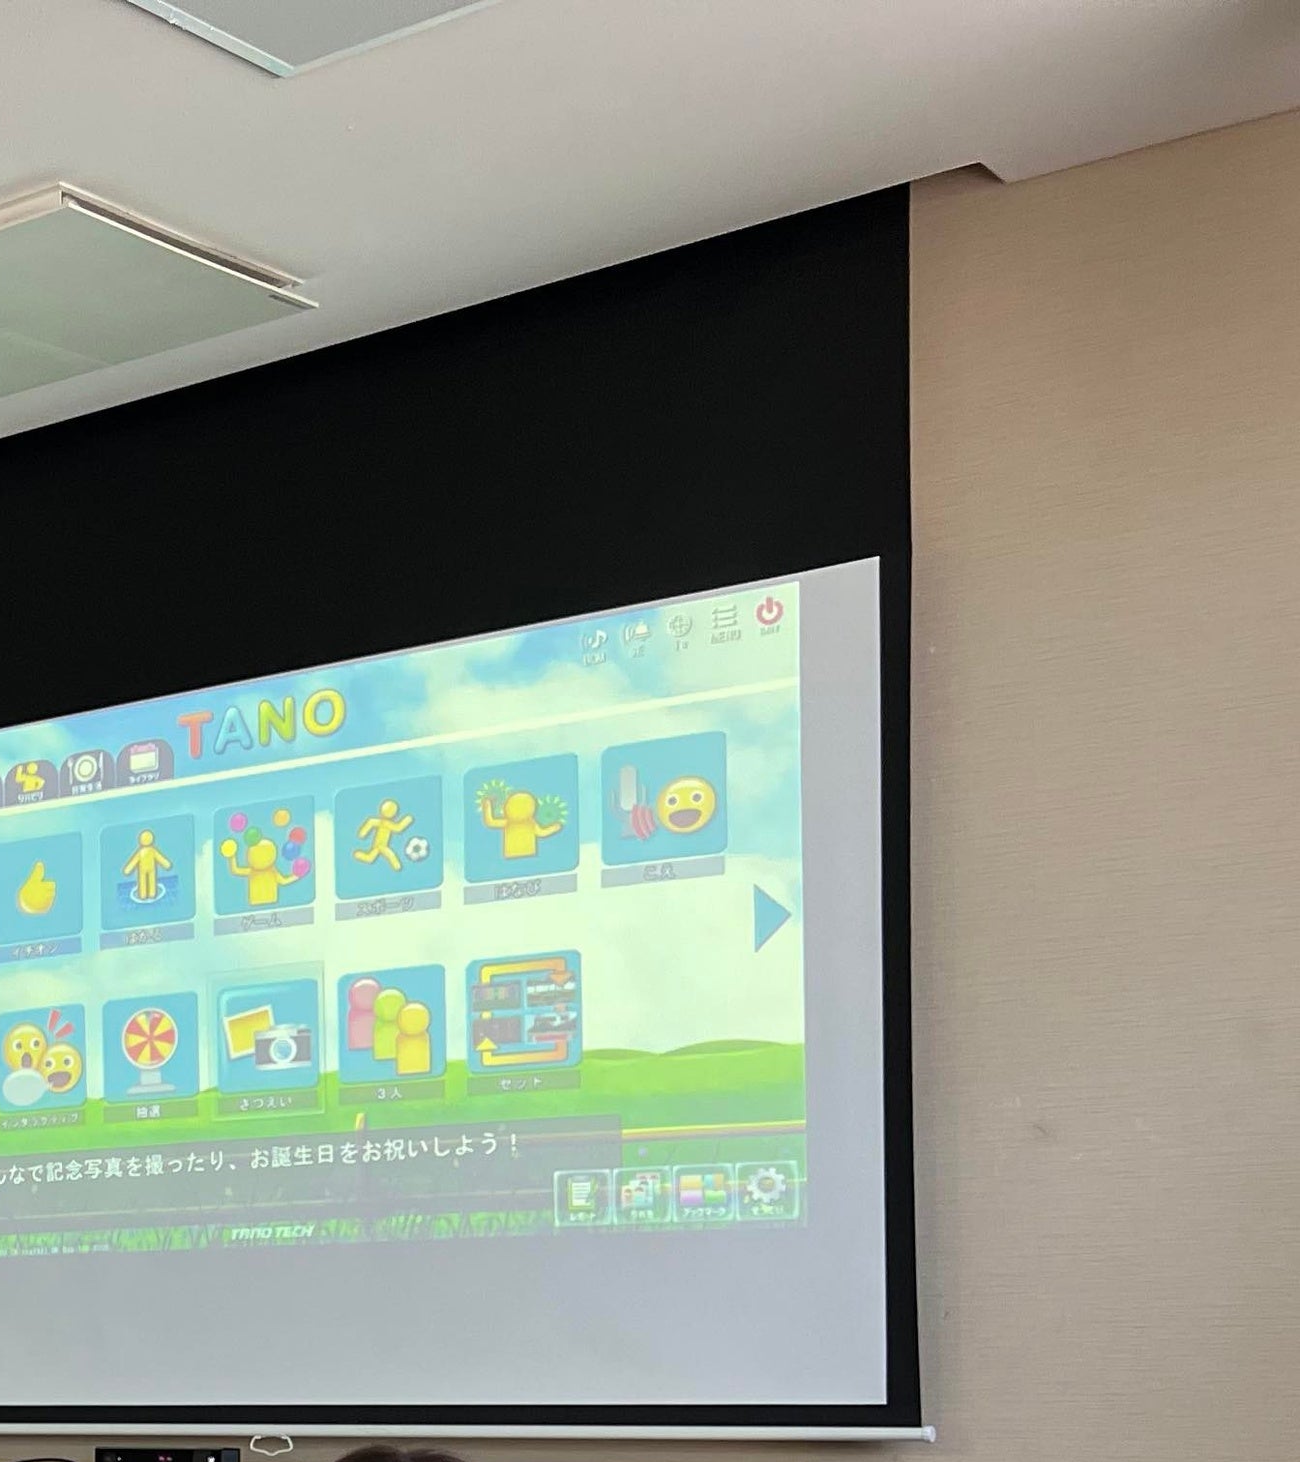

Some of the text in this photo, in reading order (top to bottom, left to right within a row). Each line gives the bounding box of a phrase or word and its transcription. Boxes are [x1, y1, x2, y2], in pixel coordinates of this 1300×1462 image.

[176, 688, 347, 759] TANO
[500, 1077, 543, 1091] セット
[239, 1096, 293, 1111] さつえい
[274, 1223, 316, 1239] TECH
